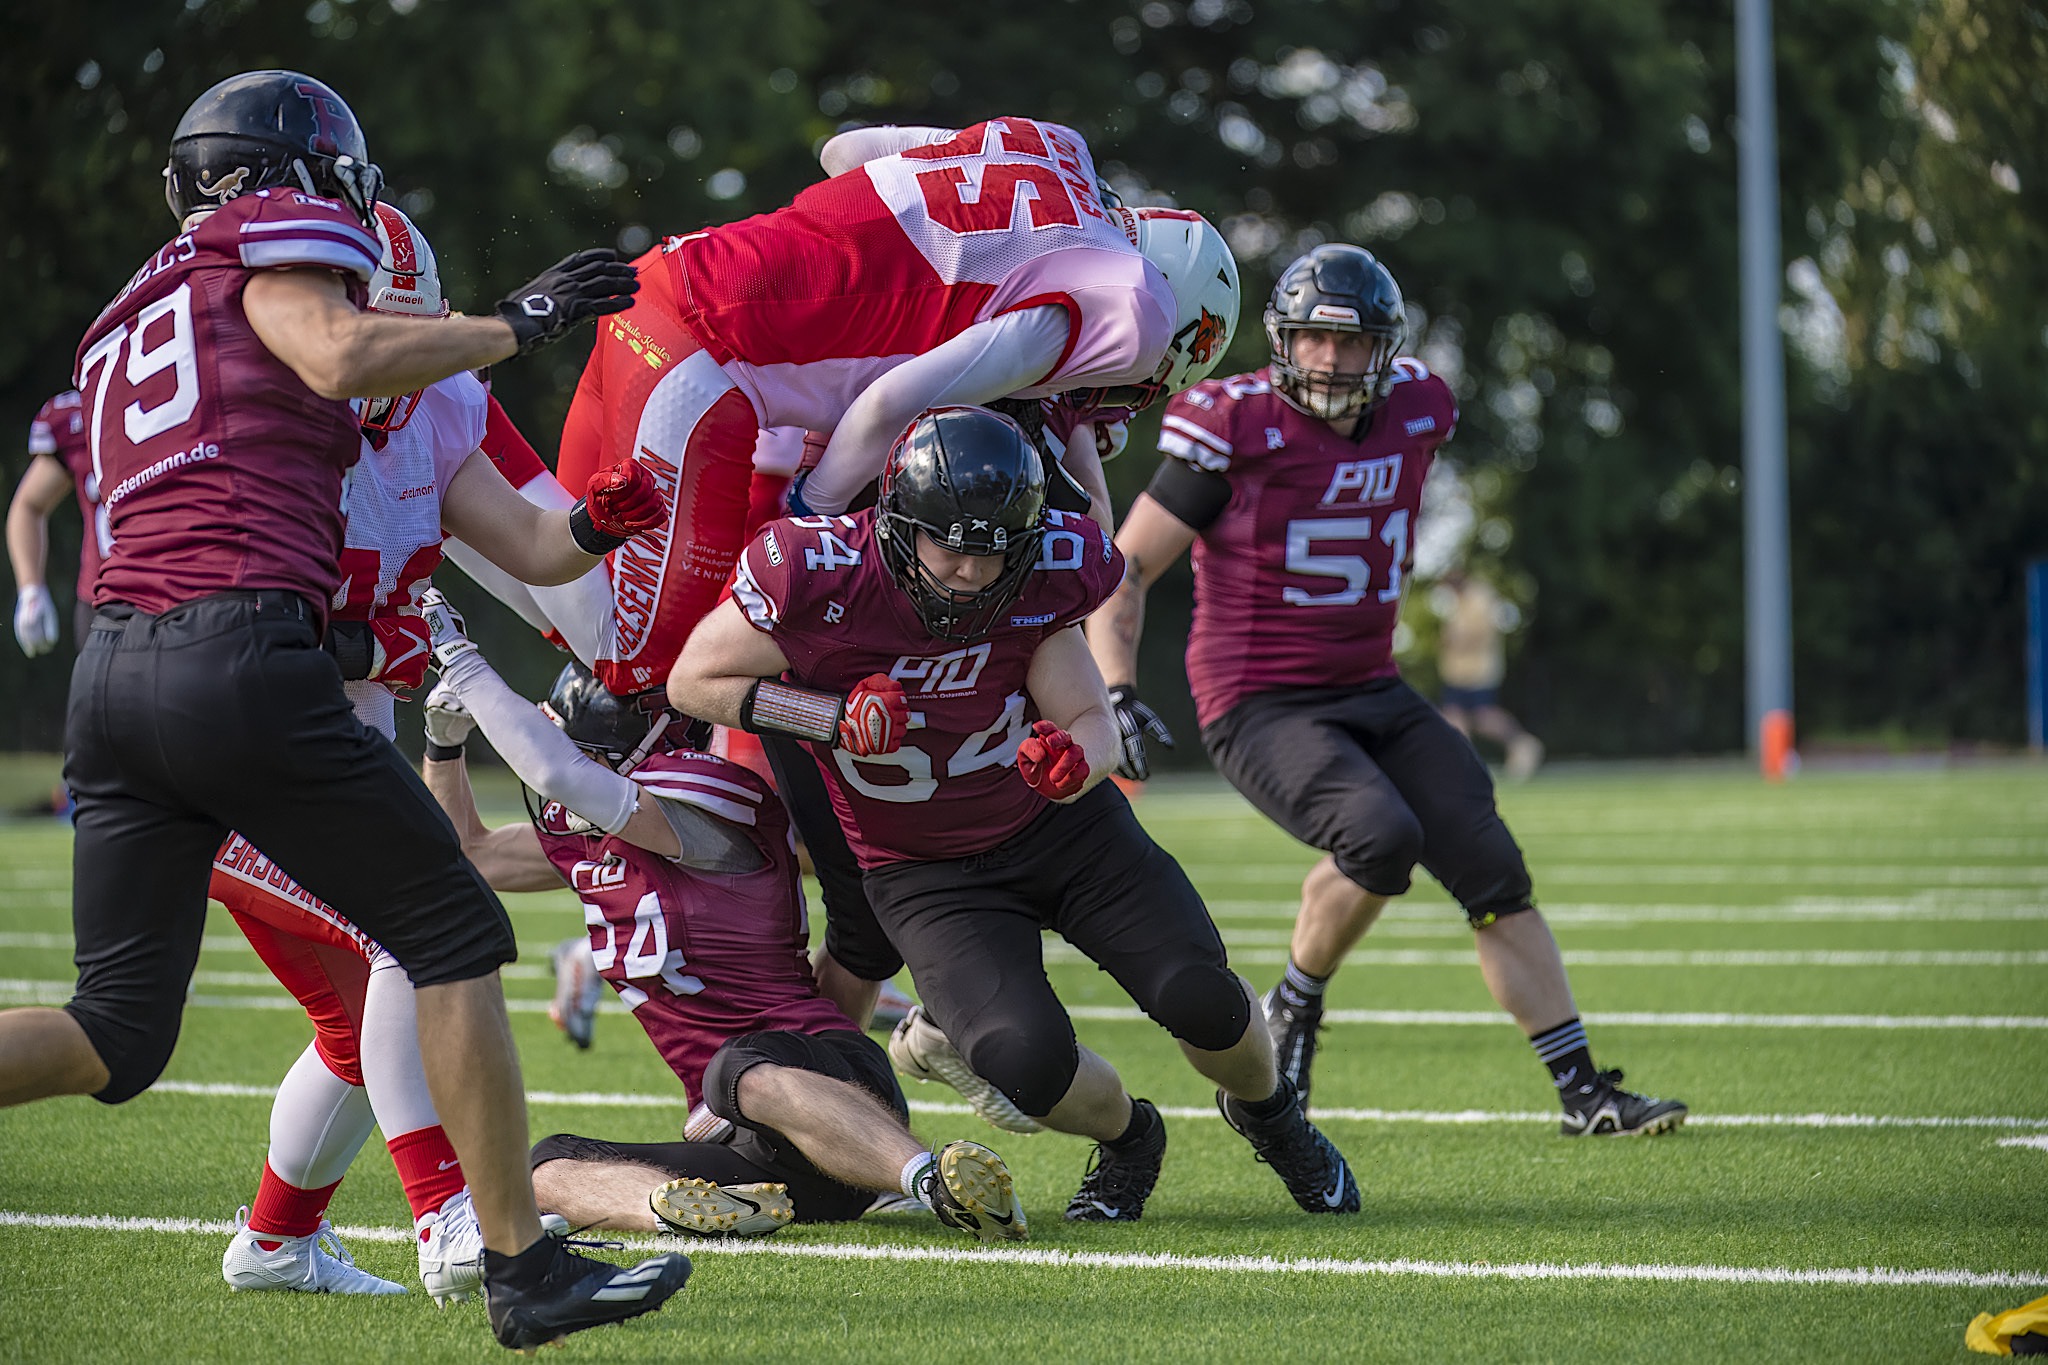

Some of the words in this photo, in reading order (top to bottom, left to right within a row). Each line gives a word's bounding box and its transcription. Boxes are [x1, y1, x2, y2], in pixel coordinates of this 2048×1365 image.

[385, 293, 424, 305] Riddell
[78, 282, 201, 488] 79
[1282, 508, 1410, 607] 51
[831, 689, 1033, 804] 64
